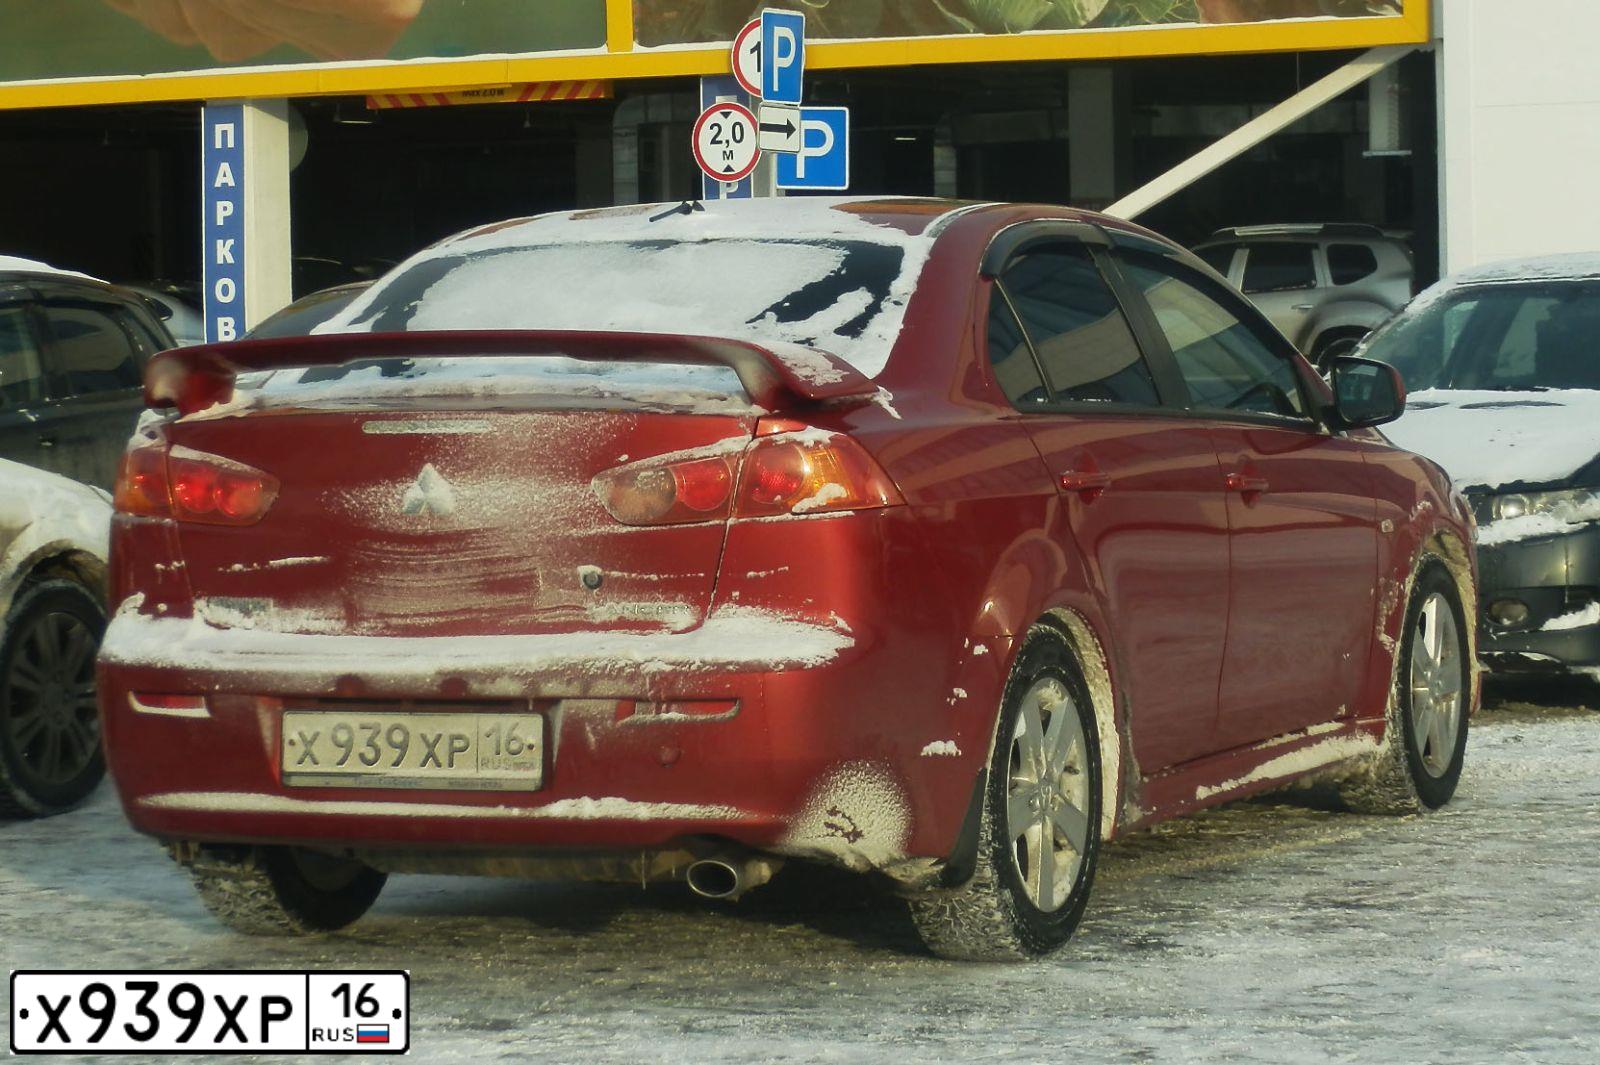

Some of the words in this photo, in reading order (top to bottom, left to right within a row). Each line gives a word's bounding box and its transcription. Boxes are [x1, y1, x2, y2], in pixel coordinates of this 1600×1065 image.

[750, 41, 762, 73] 1
[773, 26, 796, 91] P
[709, 121, 745, 148] 2,0
[796, 120, 834, 178] P
[214, 123, 237, 342] ПАРКОВ
[484, 721, 525, 756] 16
